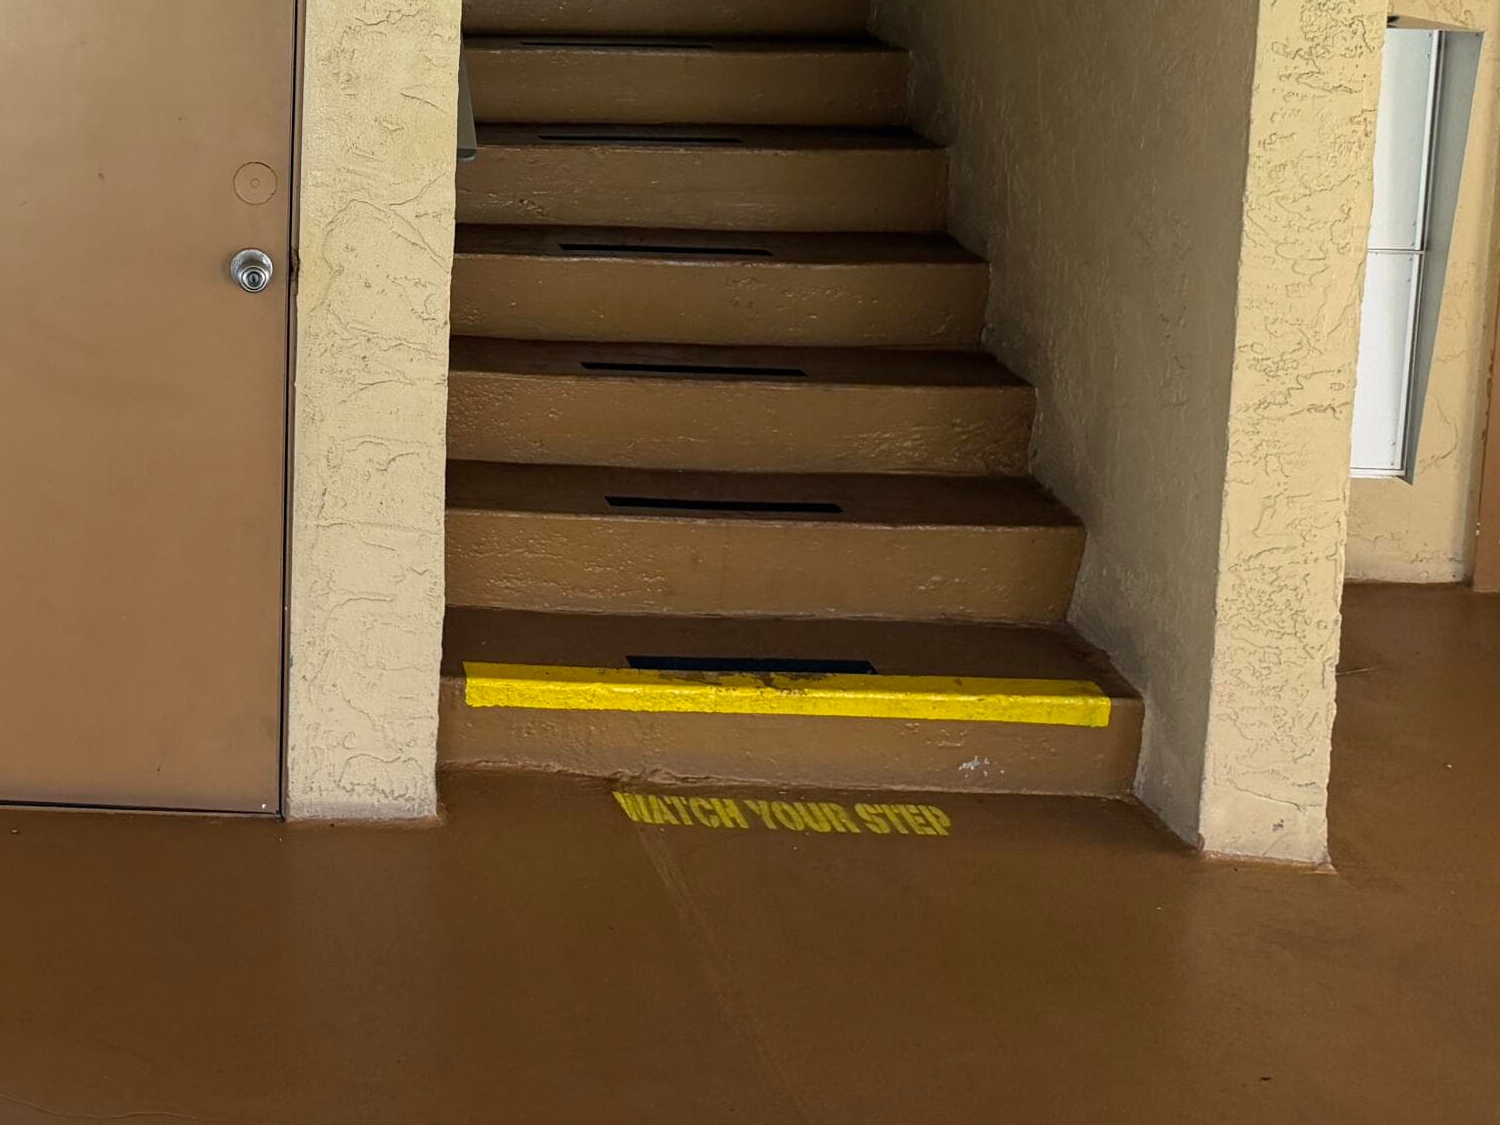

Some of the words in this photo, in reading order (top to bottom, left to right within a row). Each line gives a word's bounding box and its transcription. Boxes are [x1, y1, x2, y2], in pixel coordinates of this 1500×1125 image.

[612, 791, 749, 829] WATCH
[743, 800, 862, 833] YOUR
[853, 803, 951, 836] STEP
